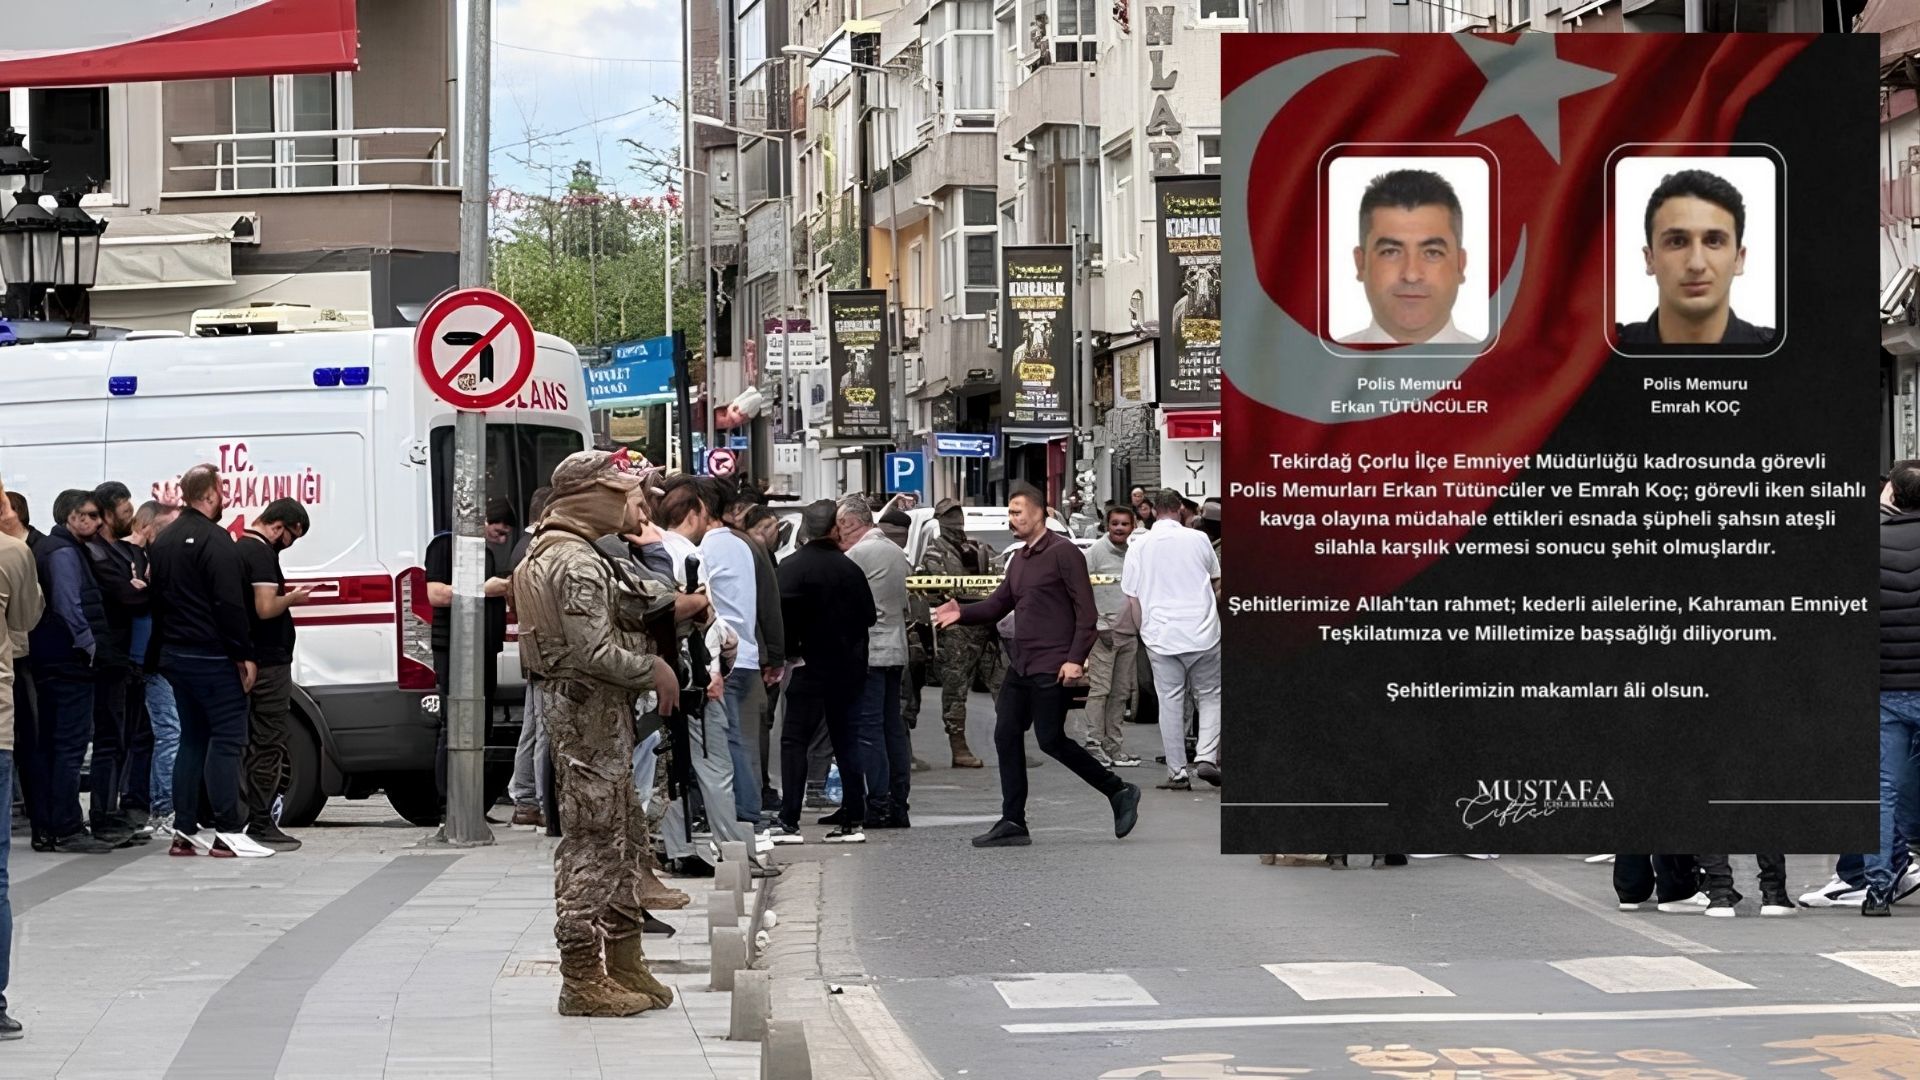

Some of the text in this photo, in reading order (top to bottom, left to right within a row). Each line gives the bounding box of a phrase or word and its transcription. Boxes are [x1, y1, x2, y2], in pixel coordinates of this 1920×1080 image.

[219, 443, 254, 473] T.C.
[893, 457, 915, 489] P
[1184, 441, 1205, 497] UYU
